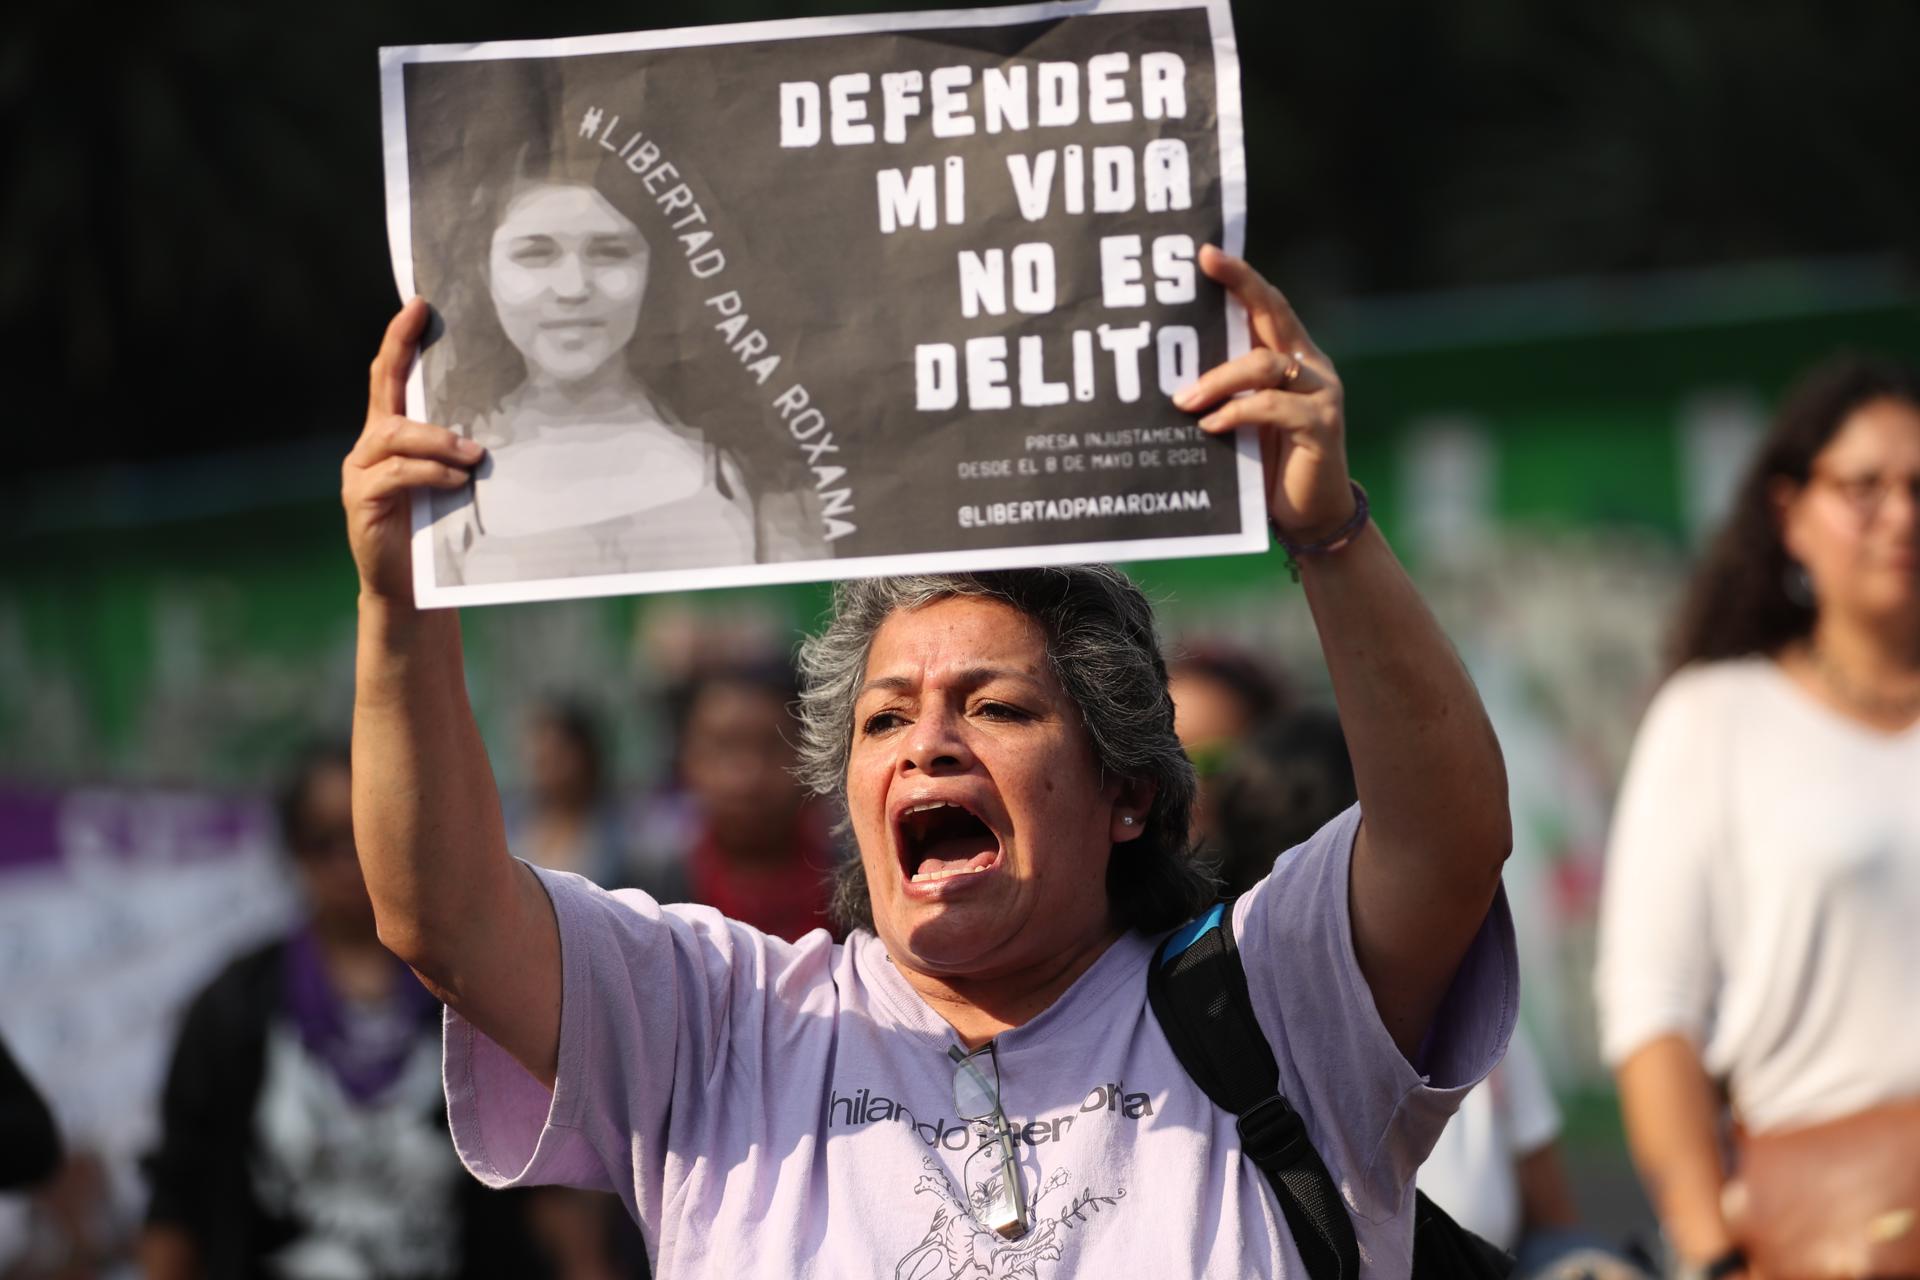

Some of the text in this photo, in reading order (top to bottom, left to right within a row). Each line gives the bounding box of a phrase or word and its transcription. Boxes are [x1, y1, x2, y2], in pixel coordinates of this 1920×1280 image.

[780, 52, 1186, 147] DEFENDER
[877, 138, 1192, 233] MI VIDA
[958, 234, 1196, 318] NO ES
[579, 106, 857, 542] #LIBERTAD PARA ROXANA
[915, 321, 1199, 411] DELITO
[958, 459, 1012, 479] DESDE
[1018, 457, 1039, 475] EL
[1063, 453, 1086, 472] DE
[1092, 451, 1133, 470] MAYO
[1139, 448, 1161, 468] DE
[1167, 447, 1208, 467] 2021
[1025, 425, 1205, 451] PRESA INJUSTAMENTE
[958, 489, 1211, 528] @LIBERTADPARAROXANA
[829, 1088, 969, 1151] hilando
